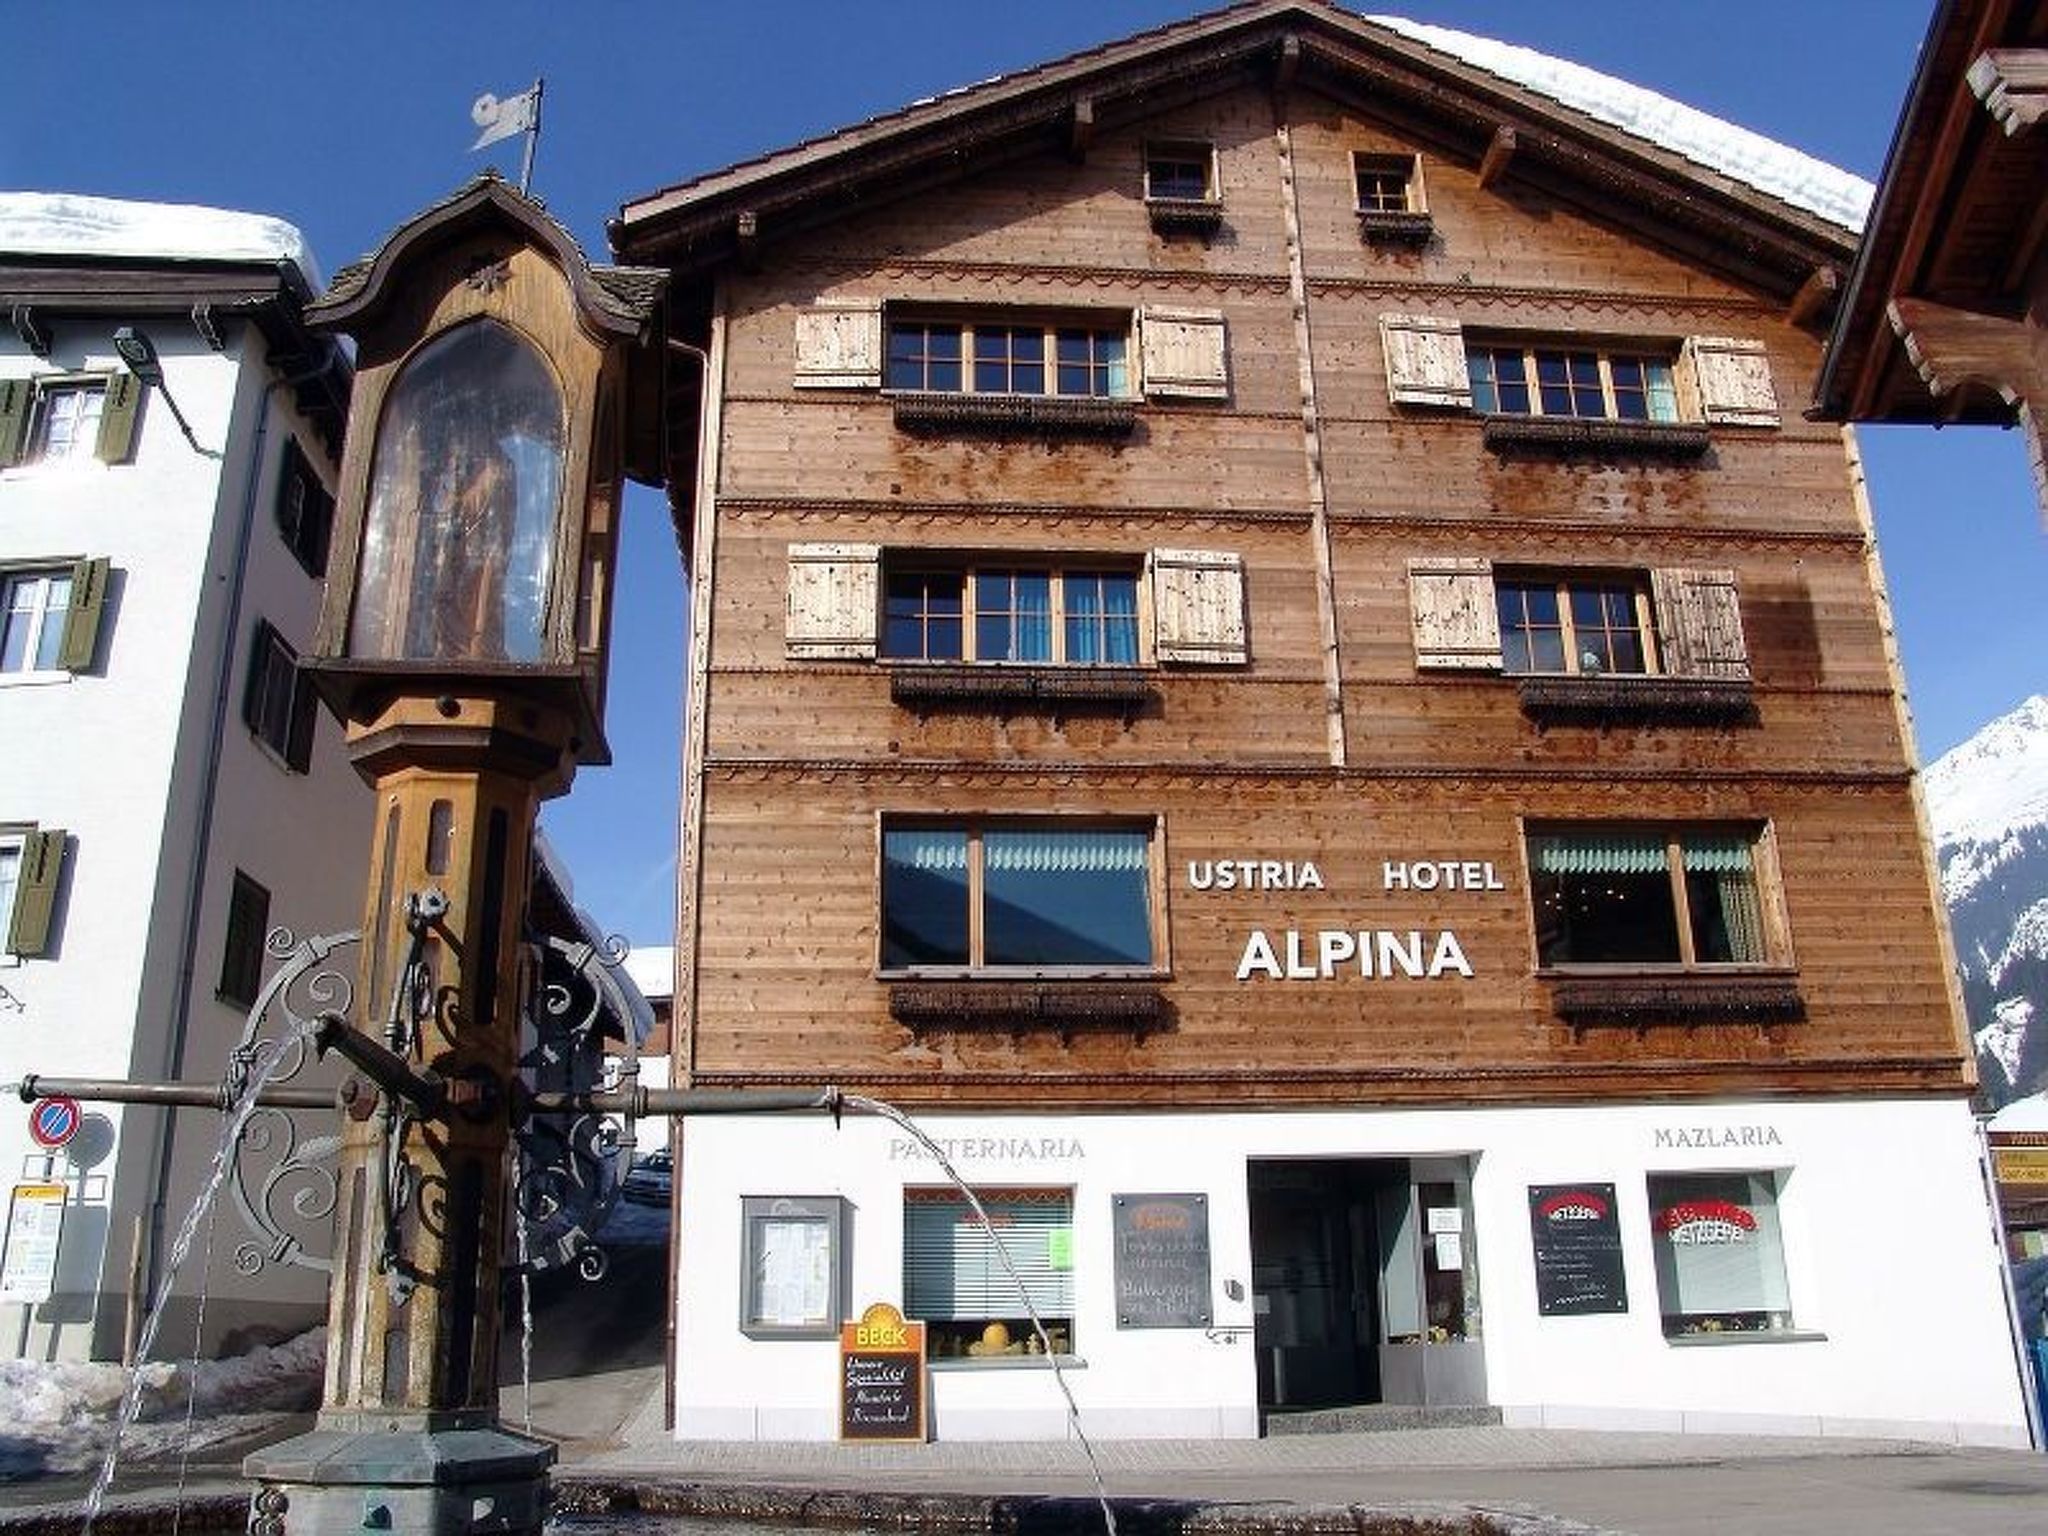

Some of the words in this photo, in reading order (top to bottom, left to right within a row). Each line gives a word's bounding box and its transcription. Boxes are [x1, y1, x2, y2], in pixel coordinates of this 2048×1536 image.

[1187, 859, 1325, 891] USTRIA
[1382, 860, 1505, 892] HOTEL
[1234, 929, 1476, 981] ALPINA
[1654, 1125, 1783, 1148] MAZLARIA
[889, 1138, 1086, 1160] PASTERNARIA
[856, 1327, 908, 1346] BECK
